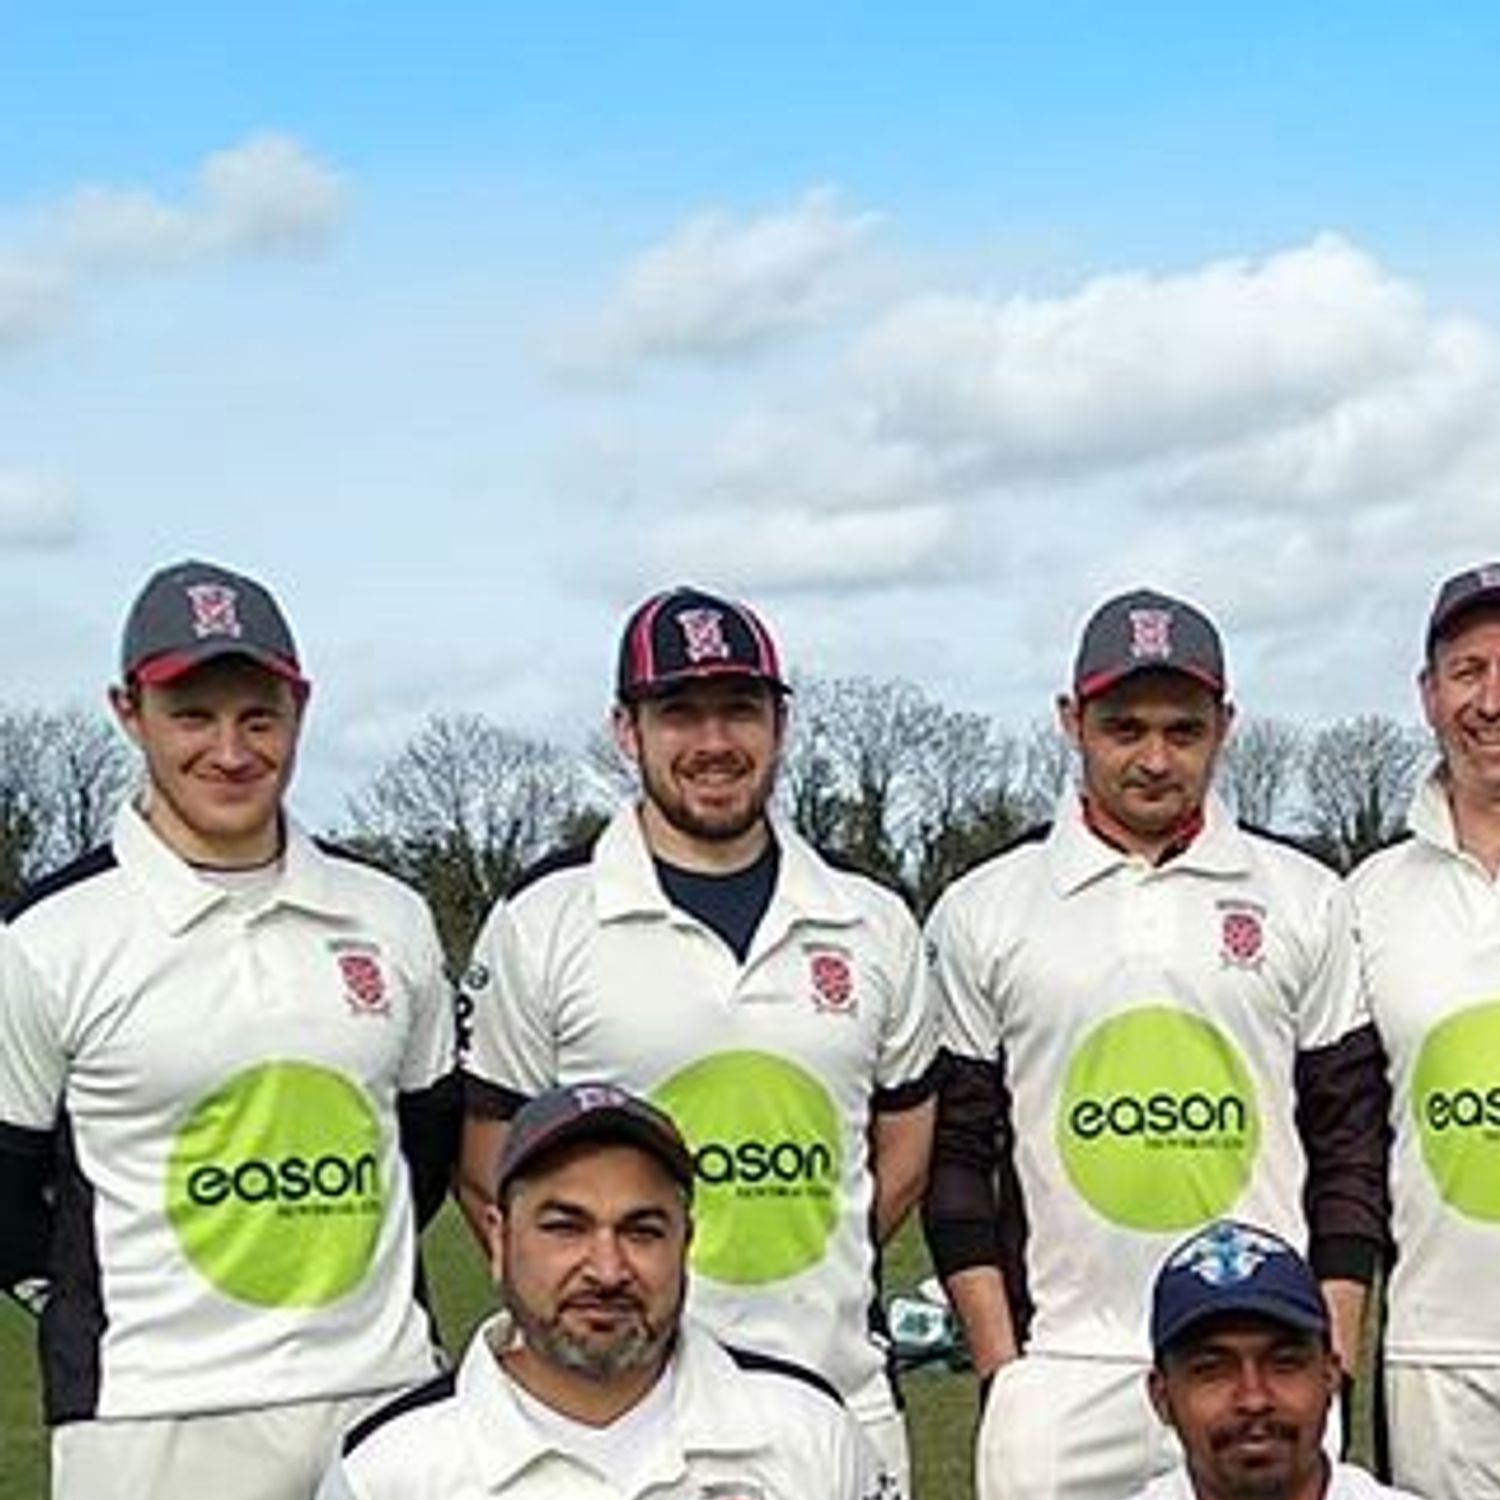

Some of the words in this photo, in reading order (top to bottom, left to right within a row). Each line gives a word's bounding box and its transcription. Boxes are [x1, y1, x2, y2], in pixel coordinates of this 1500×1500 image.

[1070, 1093, 1245, 1140] eason
[187, 1152, 377, 1206] eason
[694, 1142, 831, 1184] ason
